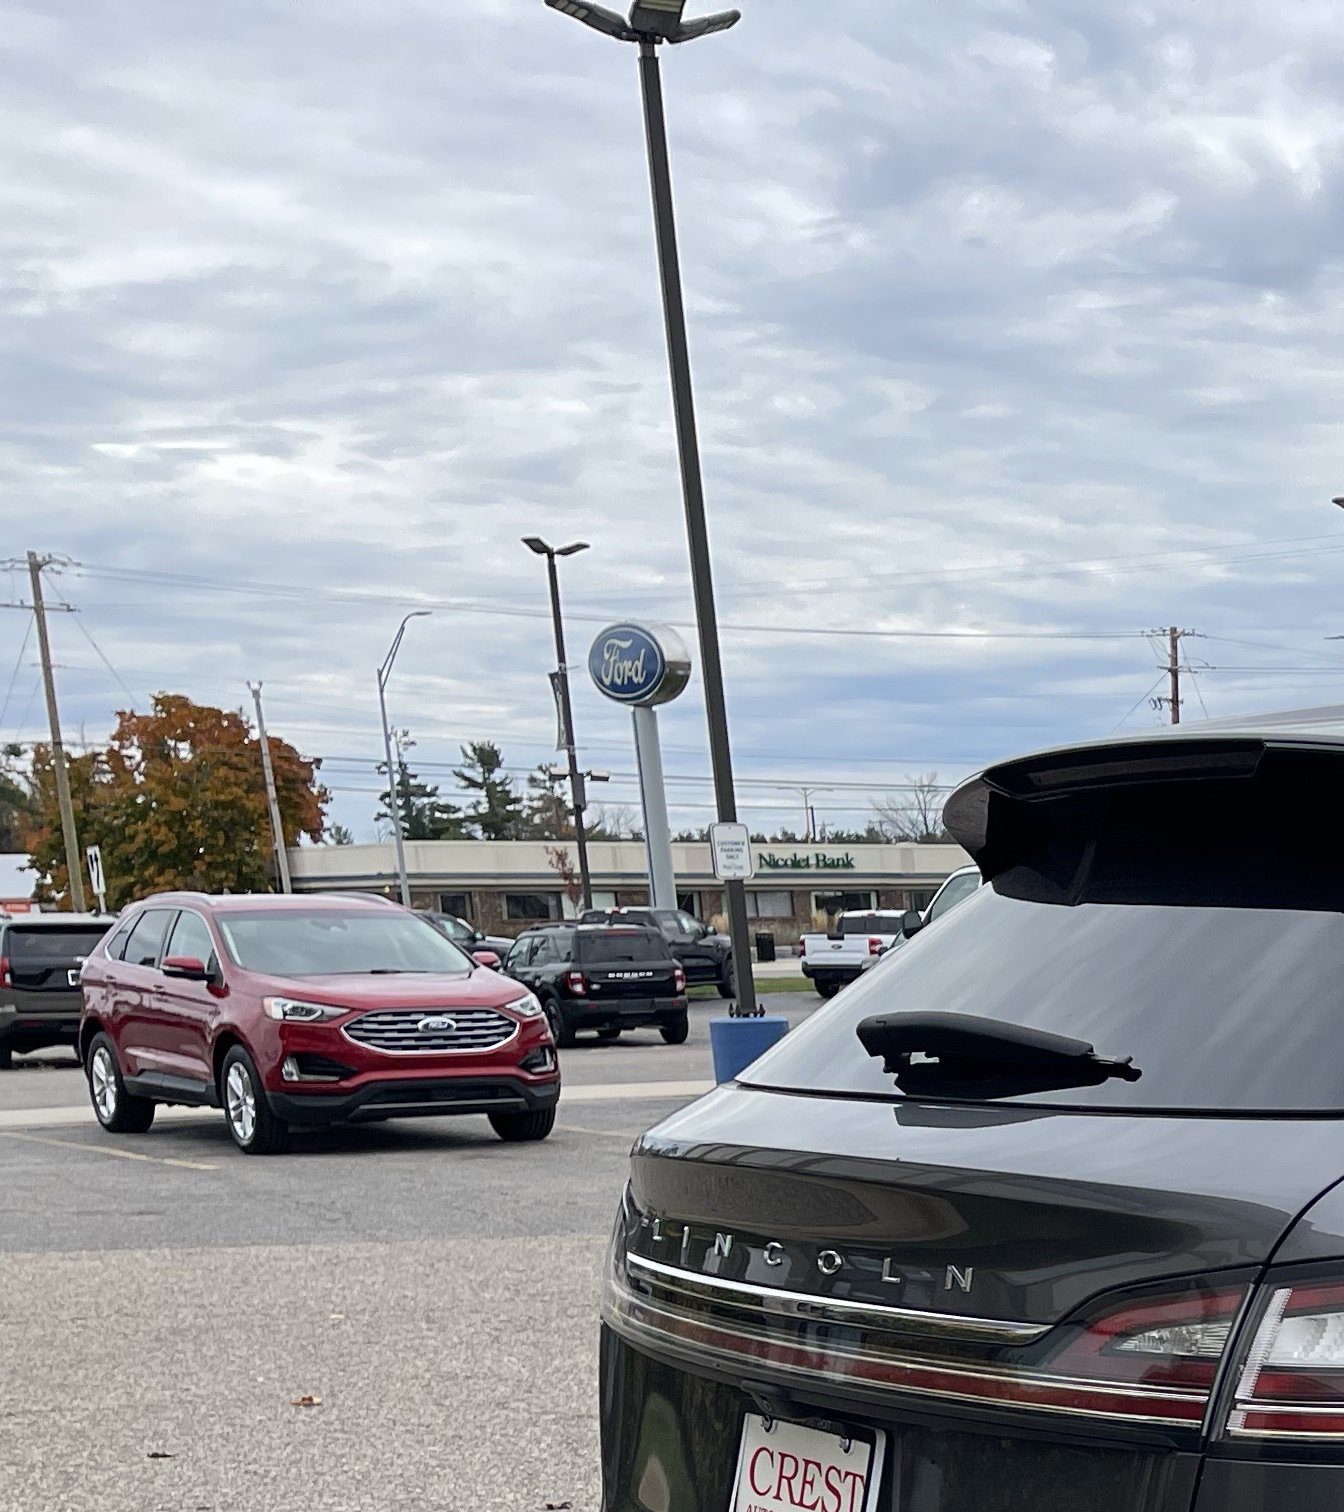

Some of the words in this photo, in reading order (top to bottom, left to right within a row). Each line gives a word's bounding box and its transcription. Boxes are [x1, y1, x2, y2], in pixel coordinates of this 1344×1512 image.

[601, 638, 647, 686] Ford
[758, 852, 810, 869] Nicolet
[815, 851, 855, 869] Bank
[652, 1219, 973, 1293] LINCOLN
